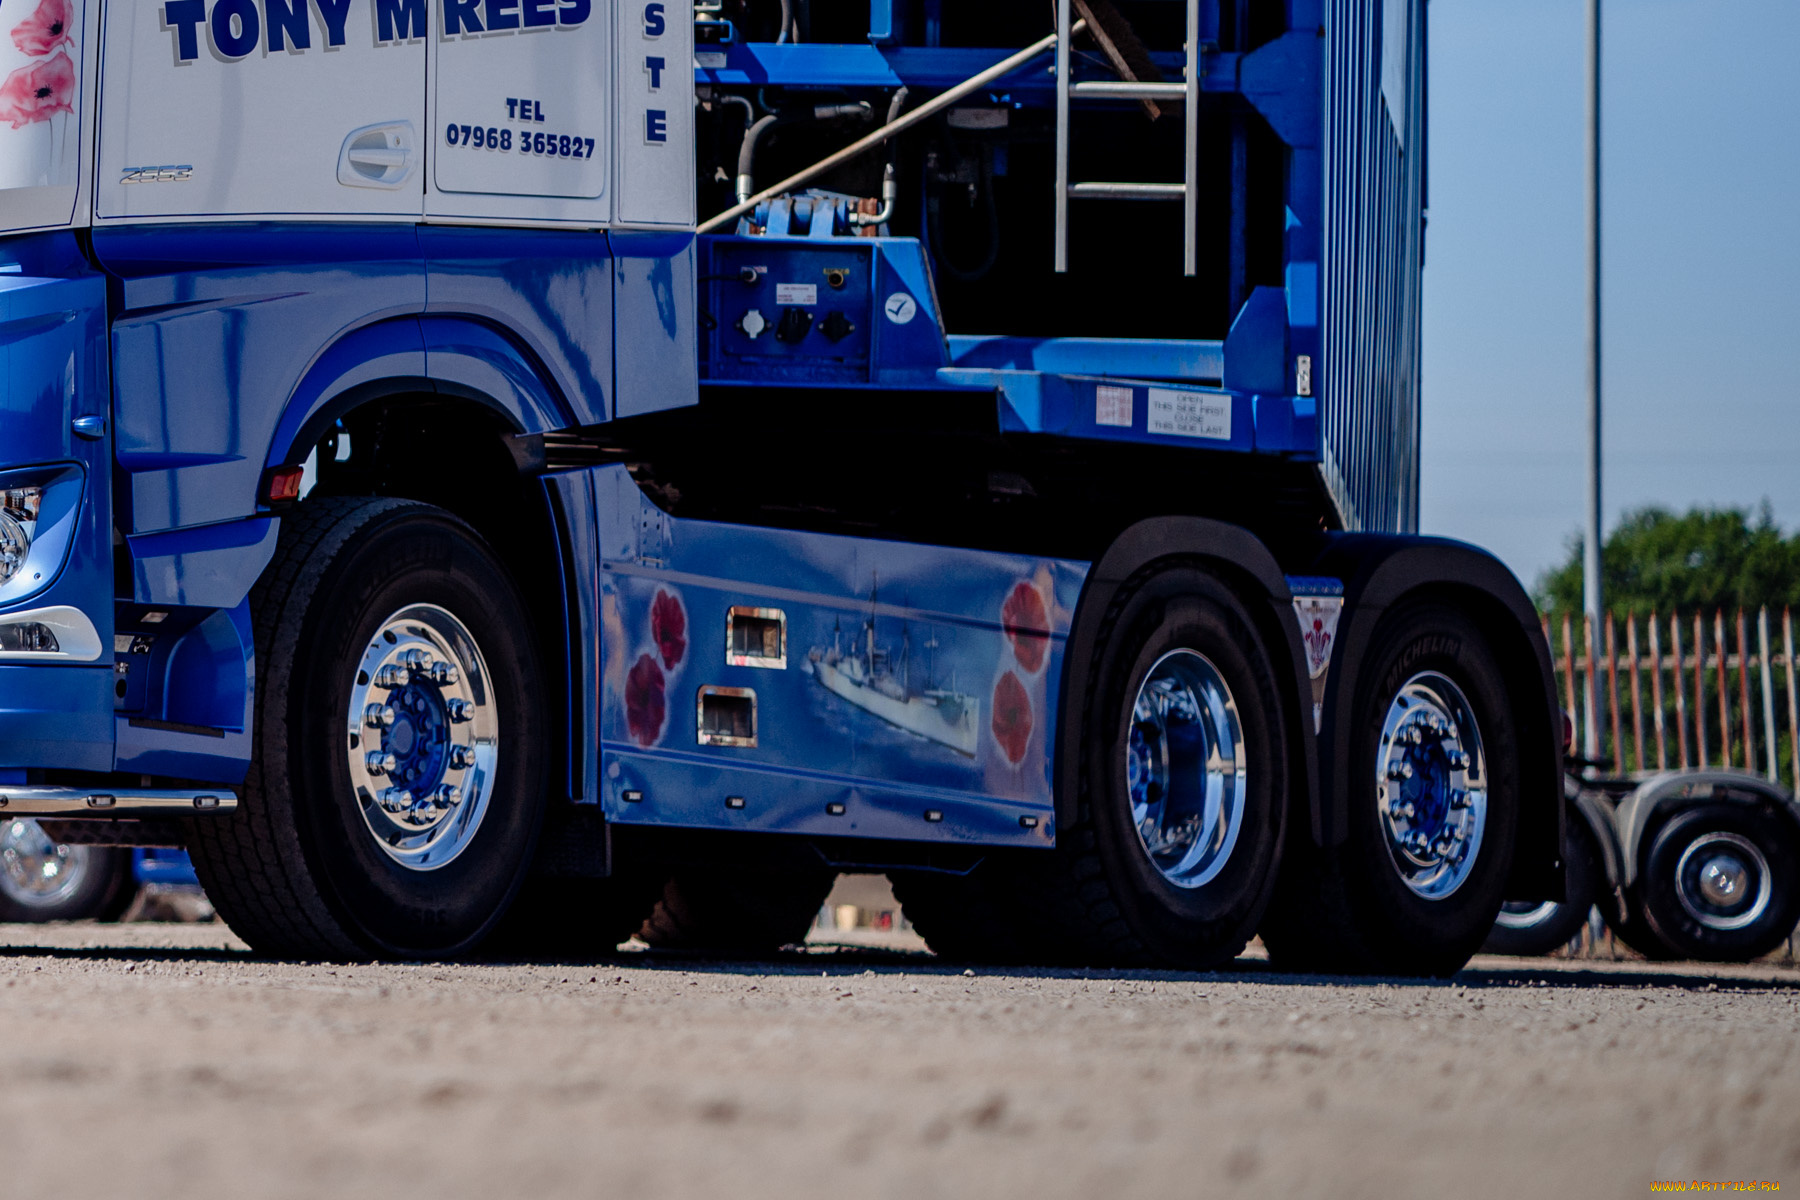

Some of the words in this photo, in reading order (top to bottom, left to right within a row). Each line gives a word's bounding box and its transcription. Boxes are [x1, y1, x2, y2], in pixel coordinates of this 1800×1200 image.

[506, 97, 545, 122] TEL
[446, 123, 512, 151] 07968
[520, 130, 595, 159] 365827
